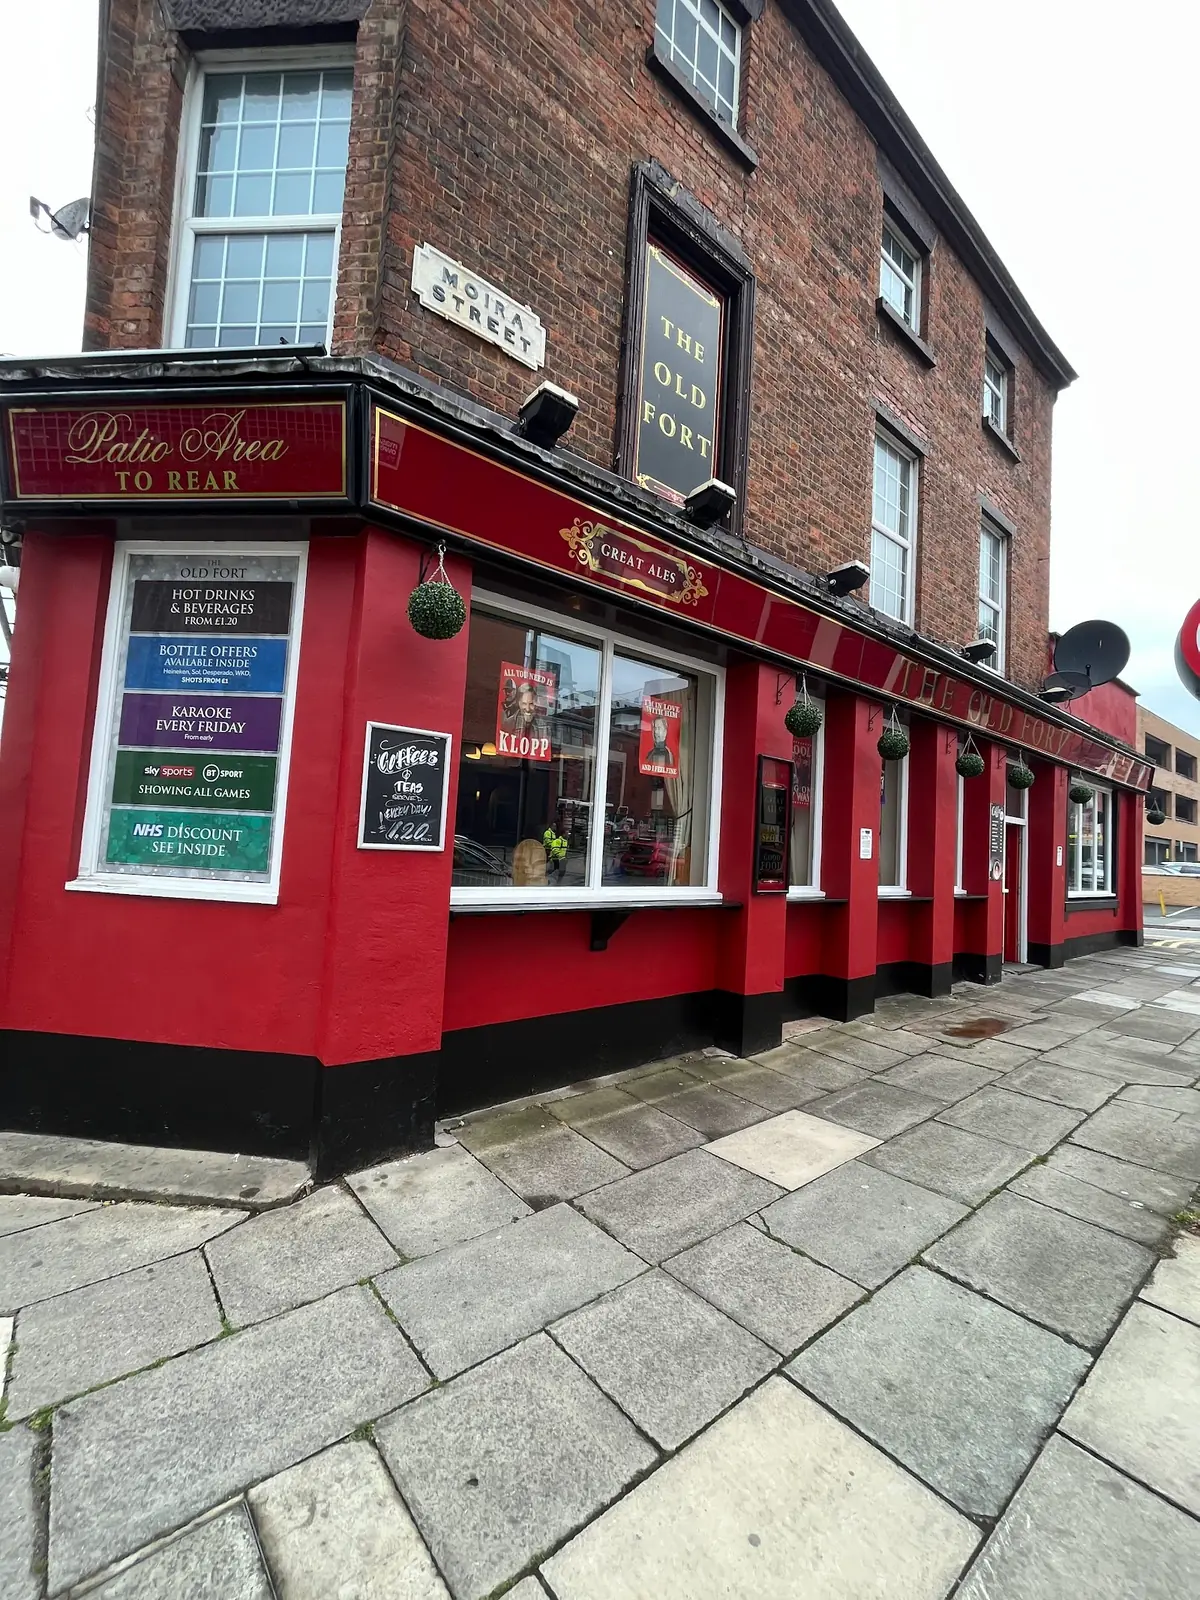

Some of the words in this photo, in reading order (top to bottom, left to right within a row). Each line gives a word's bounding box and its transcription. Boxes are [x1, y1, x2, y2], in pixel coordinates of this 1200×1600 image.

[441, 266, 523, 331] MOIRA
[432, 284, 531, 353] STREET
[660, 315, 704, 364] THE
[654, 361, 707, 409] OLD
[64, 411, 173, 464] Patio
[180, 409, 289, 462] Area
[643, 400, 711, 458] FORT
[115, 471, 153, 491] TO
[168, 470, 240, 491] REAR
[601, 543, 644, 570] GREAT
[648, 563, 676, 584] ALES
[180, 567, 208, 579] OLD
[213, 567, 247, 579] FORT
[172, 589, 202, 600] HOT
[205, 589, 255, 601] DRINKS
[170, 603, 180, 614] &
[183, 603, 254, 615] BEVERAGES
[184, 616, 213, 626] FROM
[214, 617, 238, 626] £1.20
[159, 645, 208, 657] BOTTLE
[210, 646, 257, 658] OFFERS
[164, 658, 213, 667] AVAILABLE
[215, 659, 250, 668] INSIDE
[503, 668, 515, 677] ALL
[516, 669, 529, 679] YOU
[529, 673, 546, 683] NEED
[546, 678, 553, 687] IS
[172, 706, 232, 719] KARAOKE
[663, 703, 680, 713] LOVE
[900, 656, 957, 710] THE
[967, 689, 1013, 733] OLD
[1020, 713, 1072, 755] FORT
[156, 719, 195, 732] EVERY
[197, 720, 246, 733] FRIDAY
[498, 730, 549, 757] KLOPP
[144, 766, 160, 777] sky
[162, 767, 193, 778] sports
[206, 769, 216, 777] BT
[220, 769, 243, 778] SPORT
[139, 784, 192, 796] SHOWING
[193, 787, 212, 797] ALL
[214, 787, 250, 799] GAMES
[394, 781, 423, 793] TEAS
[133, 823, 164, 837] NHS
[167, 823, 243, 842] DISCOUNT
[152, 841, 173, 854] SEE
[178, 842, 226, 857] INSIDE
